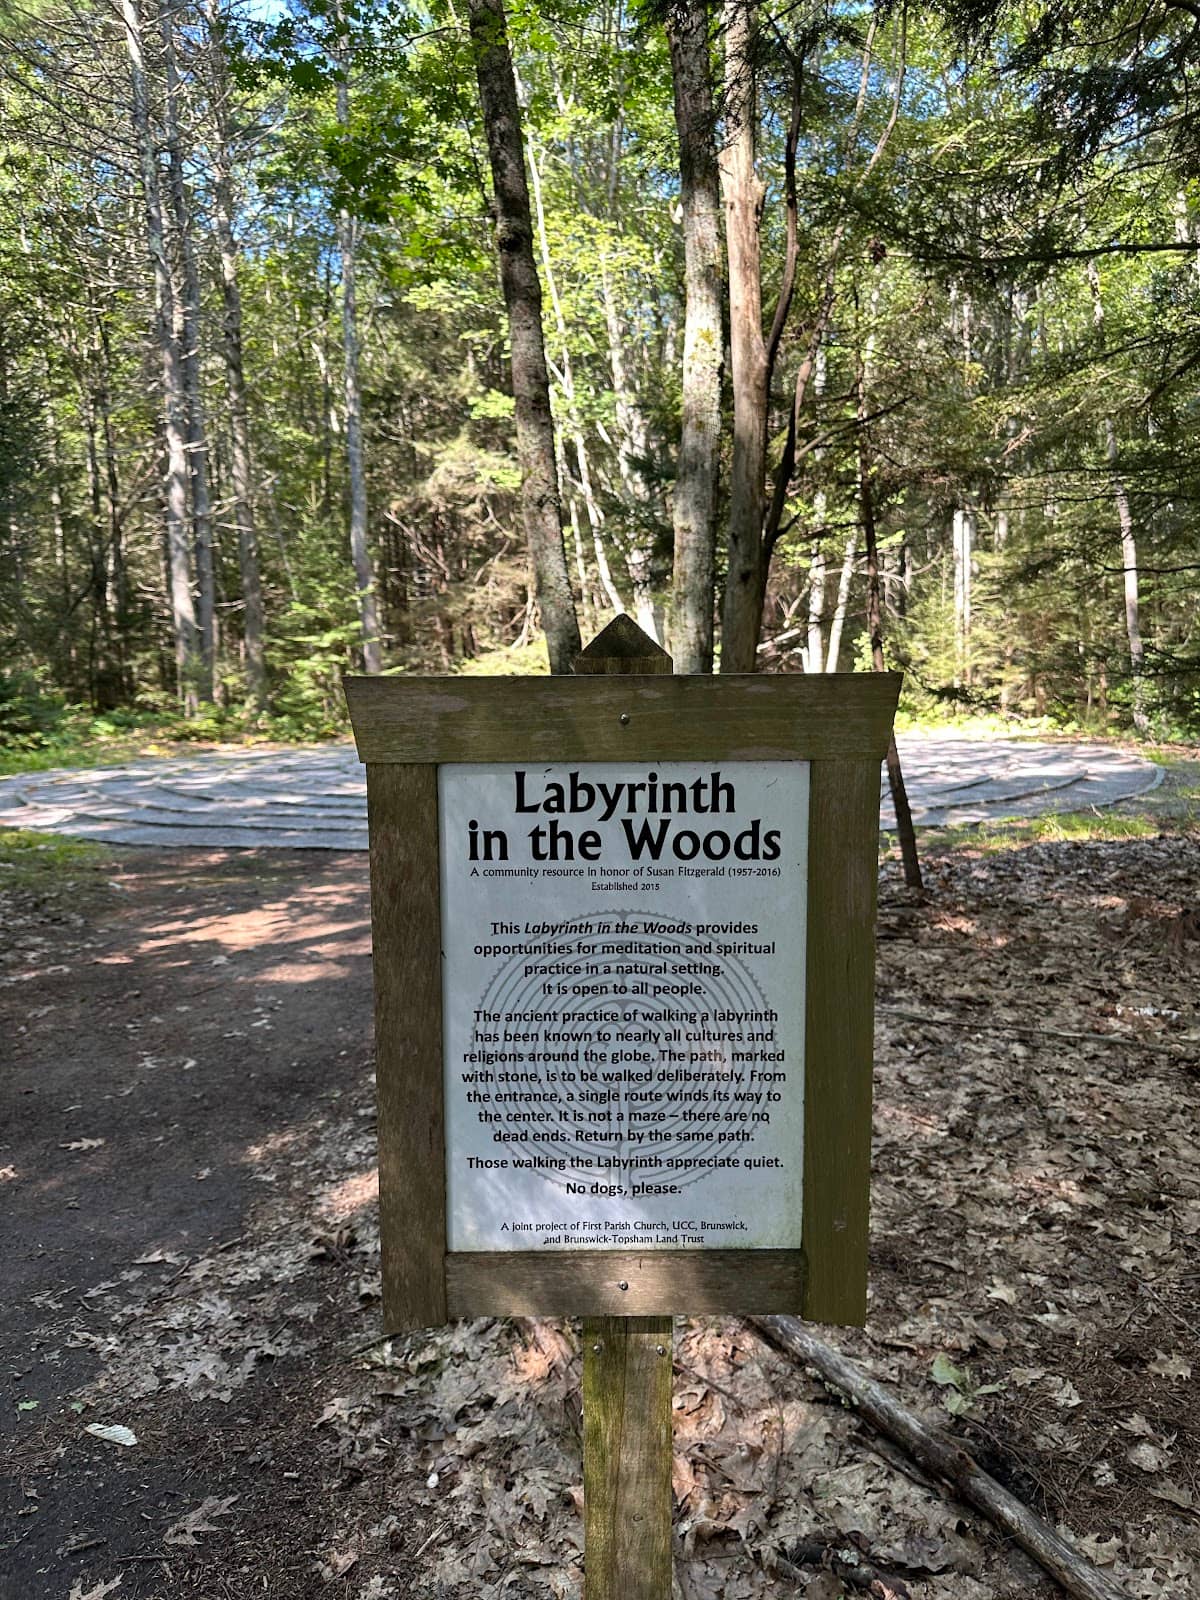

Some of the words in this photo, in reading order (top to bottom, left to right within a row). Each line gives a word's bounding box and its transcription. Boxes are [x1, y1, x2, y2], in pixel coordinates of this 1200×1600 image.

[514, 770, 736, 822] Labyrinth
[468, 819, 508, 861] in
[528, 819, 602, 861] the
[621, 818, 782, 861] Woods
[470, 867, 480, 877] A
[483, 866, 539, 879] community
[542, 868, 585, 877] resource
[587, 866, 596, 877] in
[600, 867, 630, 877] honor
[632, 866, 644, 877] of
[646, 867, 675, 877] Susan
[678, 866, 725, 879] Fitzgerald
[728, 866, 782, 878] (1957-2016)
[591, 882, 639, 891] Established
[640, 882, 660, 891] 2015
[490, 921, 521, 935] This
[524, 921, 593, 938] Labyrinth
[597, 922, 611, 935] in
[615, 922, 639, 935] the
[643, 922, 692, 935] Woods
[696, 921, 759, 938] provides
[474, 942, 572, 958] opportunities
[576, 942, 597, 955] for
[601, 942, 681, 955] meditation
[685, 942, 712, 955] and
[716, 942, 776, 958] spiritual
[524, 962, 582, 978] practice
[586, 962, 599, 975] in
[603, 965, 612, 975] a
[615, 962, 667, 975] natural
[671, 962, 725, 978] setting.
[542, 982, 554, 995] It
[557, 982, 569, 995] is
[573, 985, 609, 999] open
[612, 983, 628, 995] to
[631, 982, 649, 995] all
[653, 982, 707, 999] people.
[474, 1010, 501, 1023] The
[505, 1010, 558, 1023] ancient
[562, 1010, 619, 1026] practice
[623, 1009, 639, 1023] of
[641, 1009, 697, 1026] walking
[701, 1013, 709, 1023] a
[713, 1009, 778, 1026] labyrinth
[475, 1030, 500, 1043] has
[503, 1030, 539, 1043] been
[543, 1030, 593, 1043] known
[596, 1031, 611, 1043] to
[615, 1029, 660, 1046] nearly
[664, 1029, 681, 1043] all
[685, 1029, 743, 1043] cultures
[746, 1029, 774, 1043] and
[463, 1049, 524, 1066] religions
[527, 1049, 579, 1063] around
[583, 1049, 607, 1063] the
[611, 1049, 655, 1066] globe.
[659, 1049, 686, 1063] The
[689, 1049, 727, 1066] path,
[731, 1049, 785, 1063] marked
[461, 1069, 494, 1083] with
[498, 1070, 542, 1085] stone,
[546, 1069, 558, 1083] is
[561, 1070, 576, 1083] to
[580, 1069, 598, 1083] be
[602, 1069, 654, 1083] walked
[656, 1069, 745, 1086] deliberately.
[749, 1069, 786, 1083] From
[466, 1089, 490, 1102] the
[494, 1090, 562, 1105] entrance,
[565, 1093, 574, 1102] a
[578, 1089, 620, 1106] single
[624, 1090, 663, 1102] route
[666, 1089, 709, 1102] winds
[713, 1089, 730, 1102] its
[733, 1093, 763, 1106] way
[765, 1090, 782, 1102] to
[478, 1109, 502, 1123] the
[505, 1110, 554, 1123] center.
[558, 1109, 569, 1123] It
[572, 1109, 584, 1123] is
[587, 1110, 613, 1123] not
[616, 1113, 625, 1123] a
[628, 1113, 666, 1123] maze
[682, 1109, 720, 1122] there
[724, 1112, 748, 1122] are
[751, 1112, 770, 1123] no
[493, 1129, 528, 1142] dead
[532, 1129, 571, 1142] ends.
[575, 1129, 623, 1142] Return
[627, 1129, 645, 1146] by
[648, 1129, 672, 1142] the
[675, 1133, 714, 1142] same
[717, 1129, 755, 1146] path.
[466, 1156, 509, 1169] Those
[512, 1156, 566, 1172] walking
[569, 1156, 593, 1169] the
[597, 1156, 663, 1172] Labyrinth
[666, 1156, 740, 1172] appreciate
[743, 1156, 784, 1172] quiet.
[566, 1183, 587, 1195] No
[590, 1182, 628, 1198] dogs,
[632, 1182, 682, 1198] please.
[500, 1221, 509, 1231] A
[511, 1221, 533, 1233] joint
[535, 1221, 568, 1233] project
[570, 1220, 581, 1230] of
[582, 1220, 602, 1230] First
[604, 1220, 631, 1230] Parish
[633, 1220, 670, 1232] Church,
[672, 1221, 698, 1232] UCC,
[700, 1220, 748, 1232] Brunswick,
[543, 1234, 561, 1245] and
[564, 1234, 653, 1246] Brunswick-Topsham
[656, 1234, 678, 1244] Land
[680, 1234, 704, 1244] Trust
